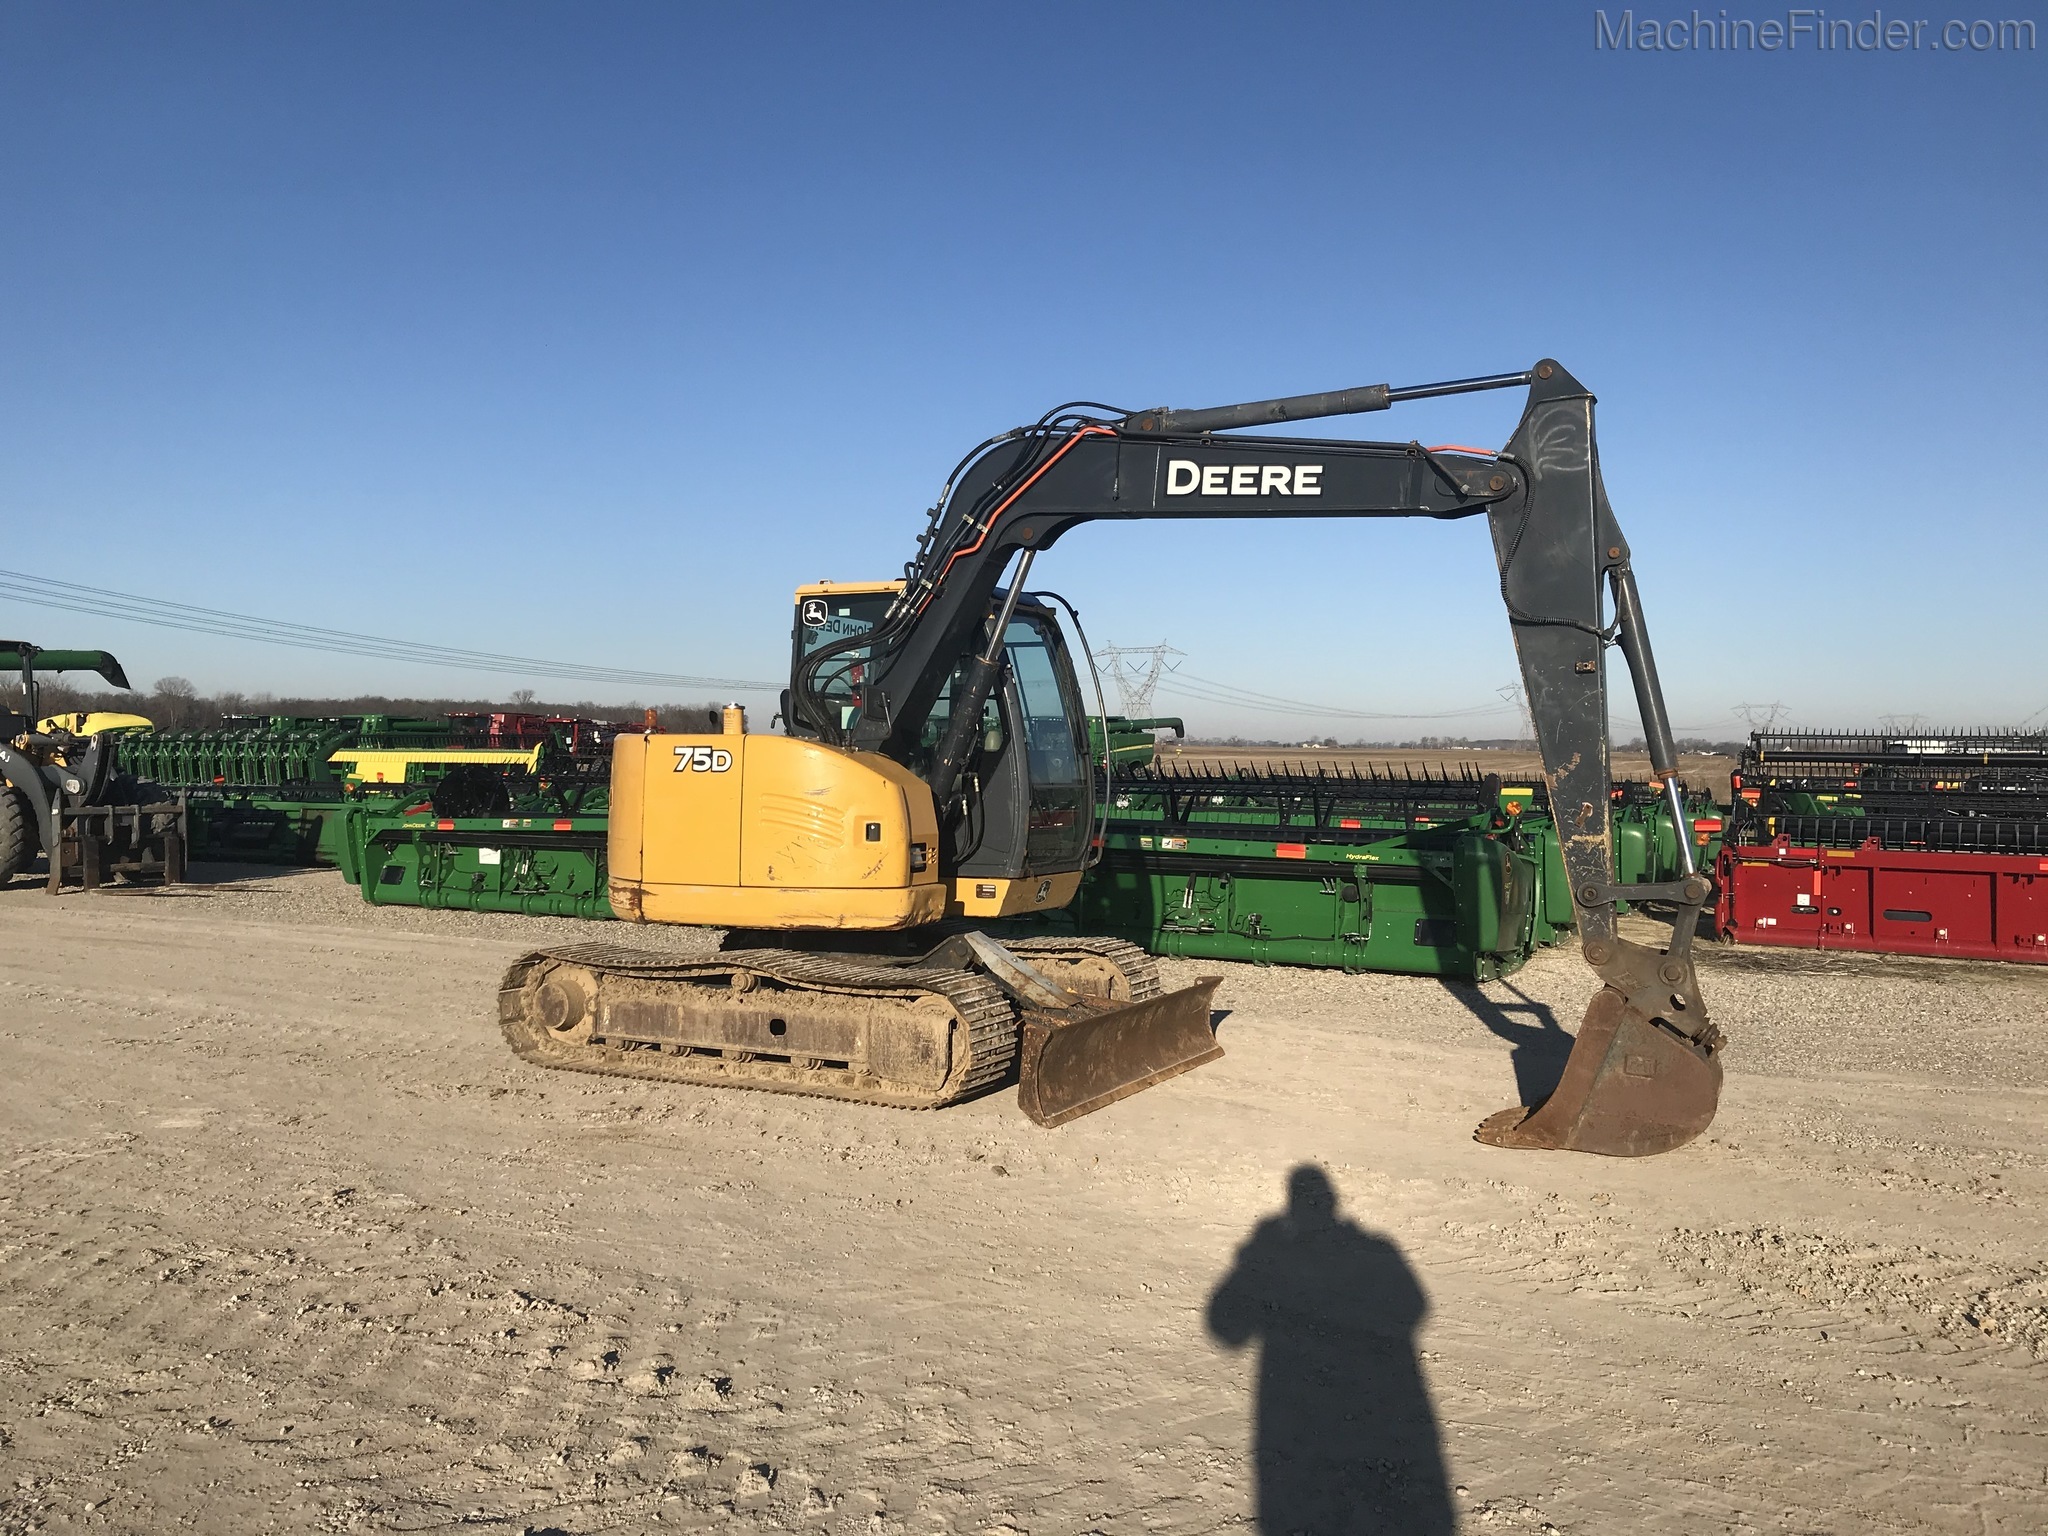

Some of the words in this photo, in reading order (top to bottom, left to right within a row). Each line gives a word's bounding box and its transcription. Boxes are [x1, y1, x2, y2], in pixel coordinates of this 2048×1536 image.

[1166, 459, 1323, 495] DEERE
[673, 746, 732, 772] 75D
[1345, 853, 1380, 861] HydraFlex
